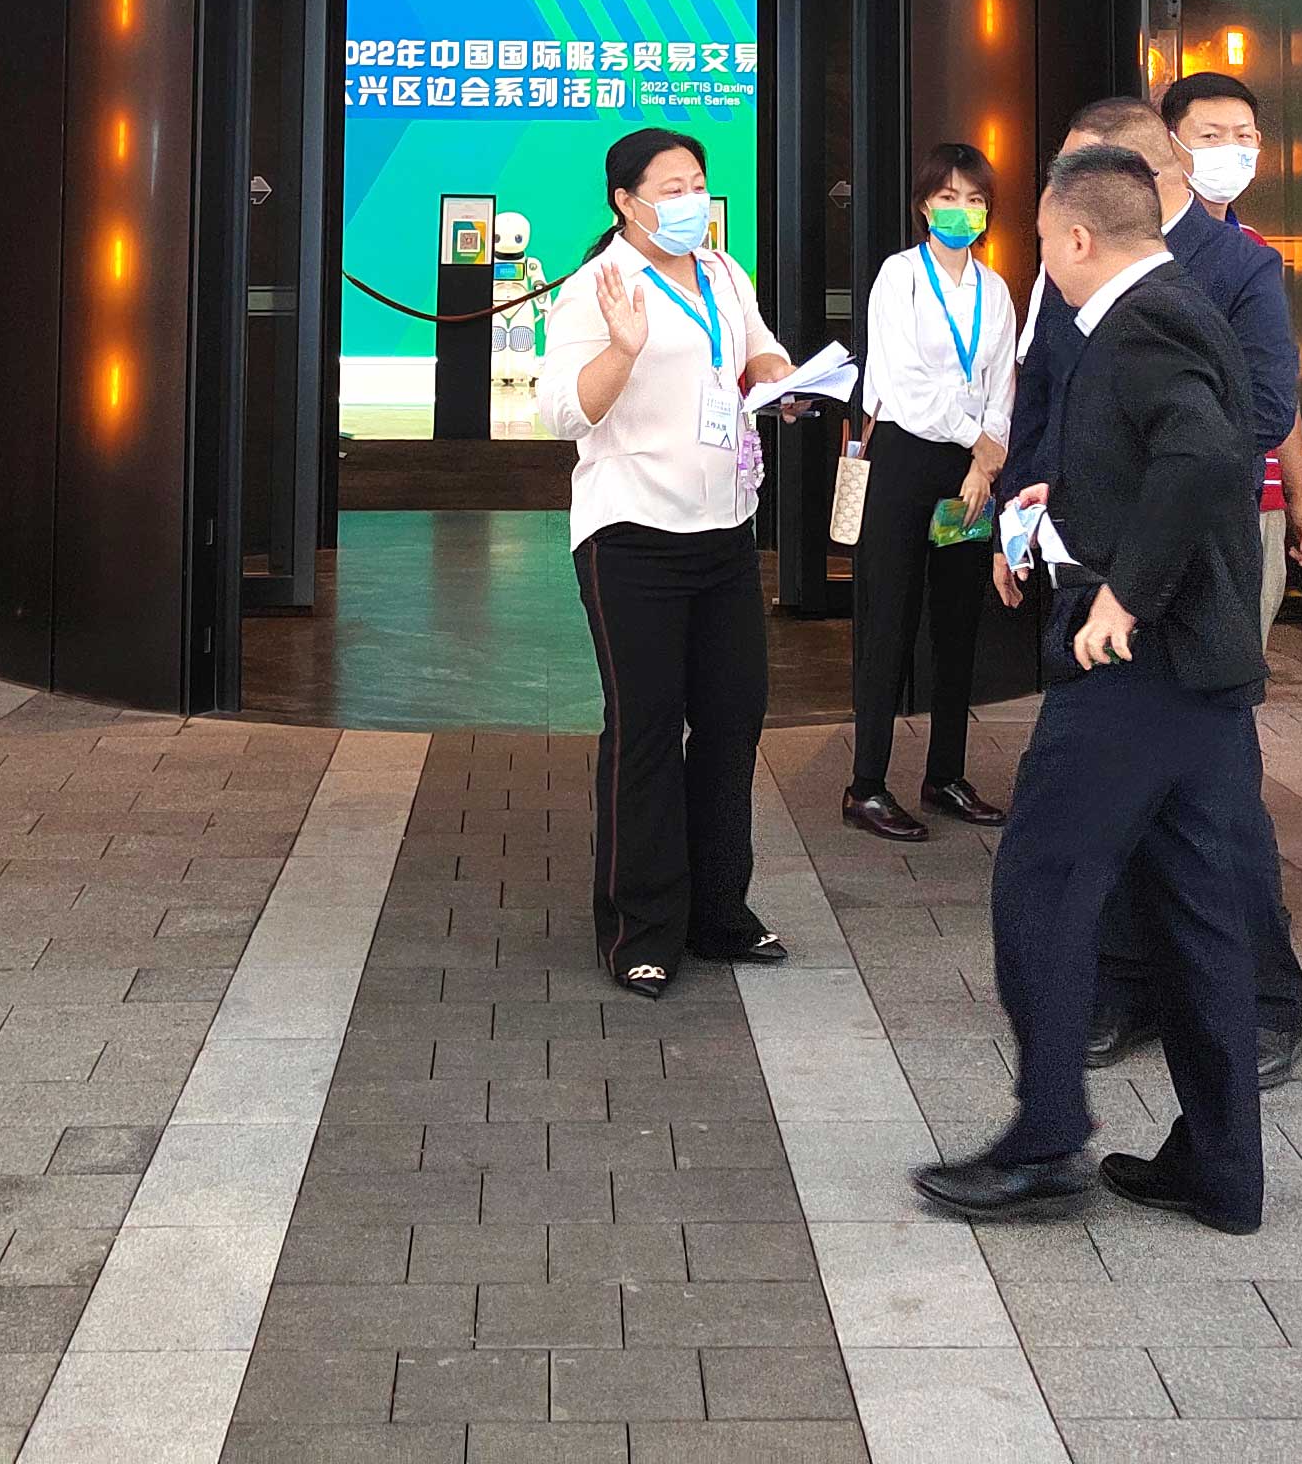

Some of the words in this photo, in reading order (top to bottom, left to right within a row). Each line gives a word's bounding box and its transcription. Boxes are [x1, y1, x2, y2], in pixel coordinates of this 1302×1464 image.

[641, 82, 669, 93] 2022
[671, 82, 711, 93] CIFTIS
[714, 83, 754, 95] Daxing
[641, 95, 666, 105] Side
[669, 95, 701, 106] Event
[704, 95, 741, 106] Series
